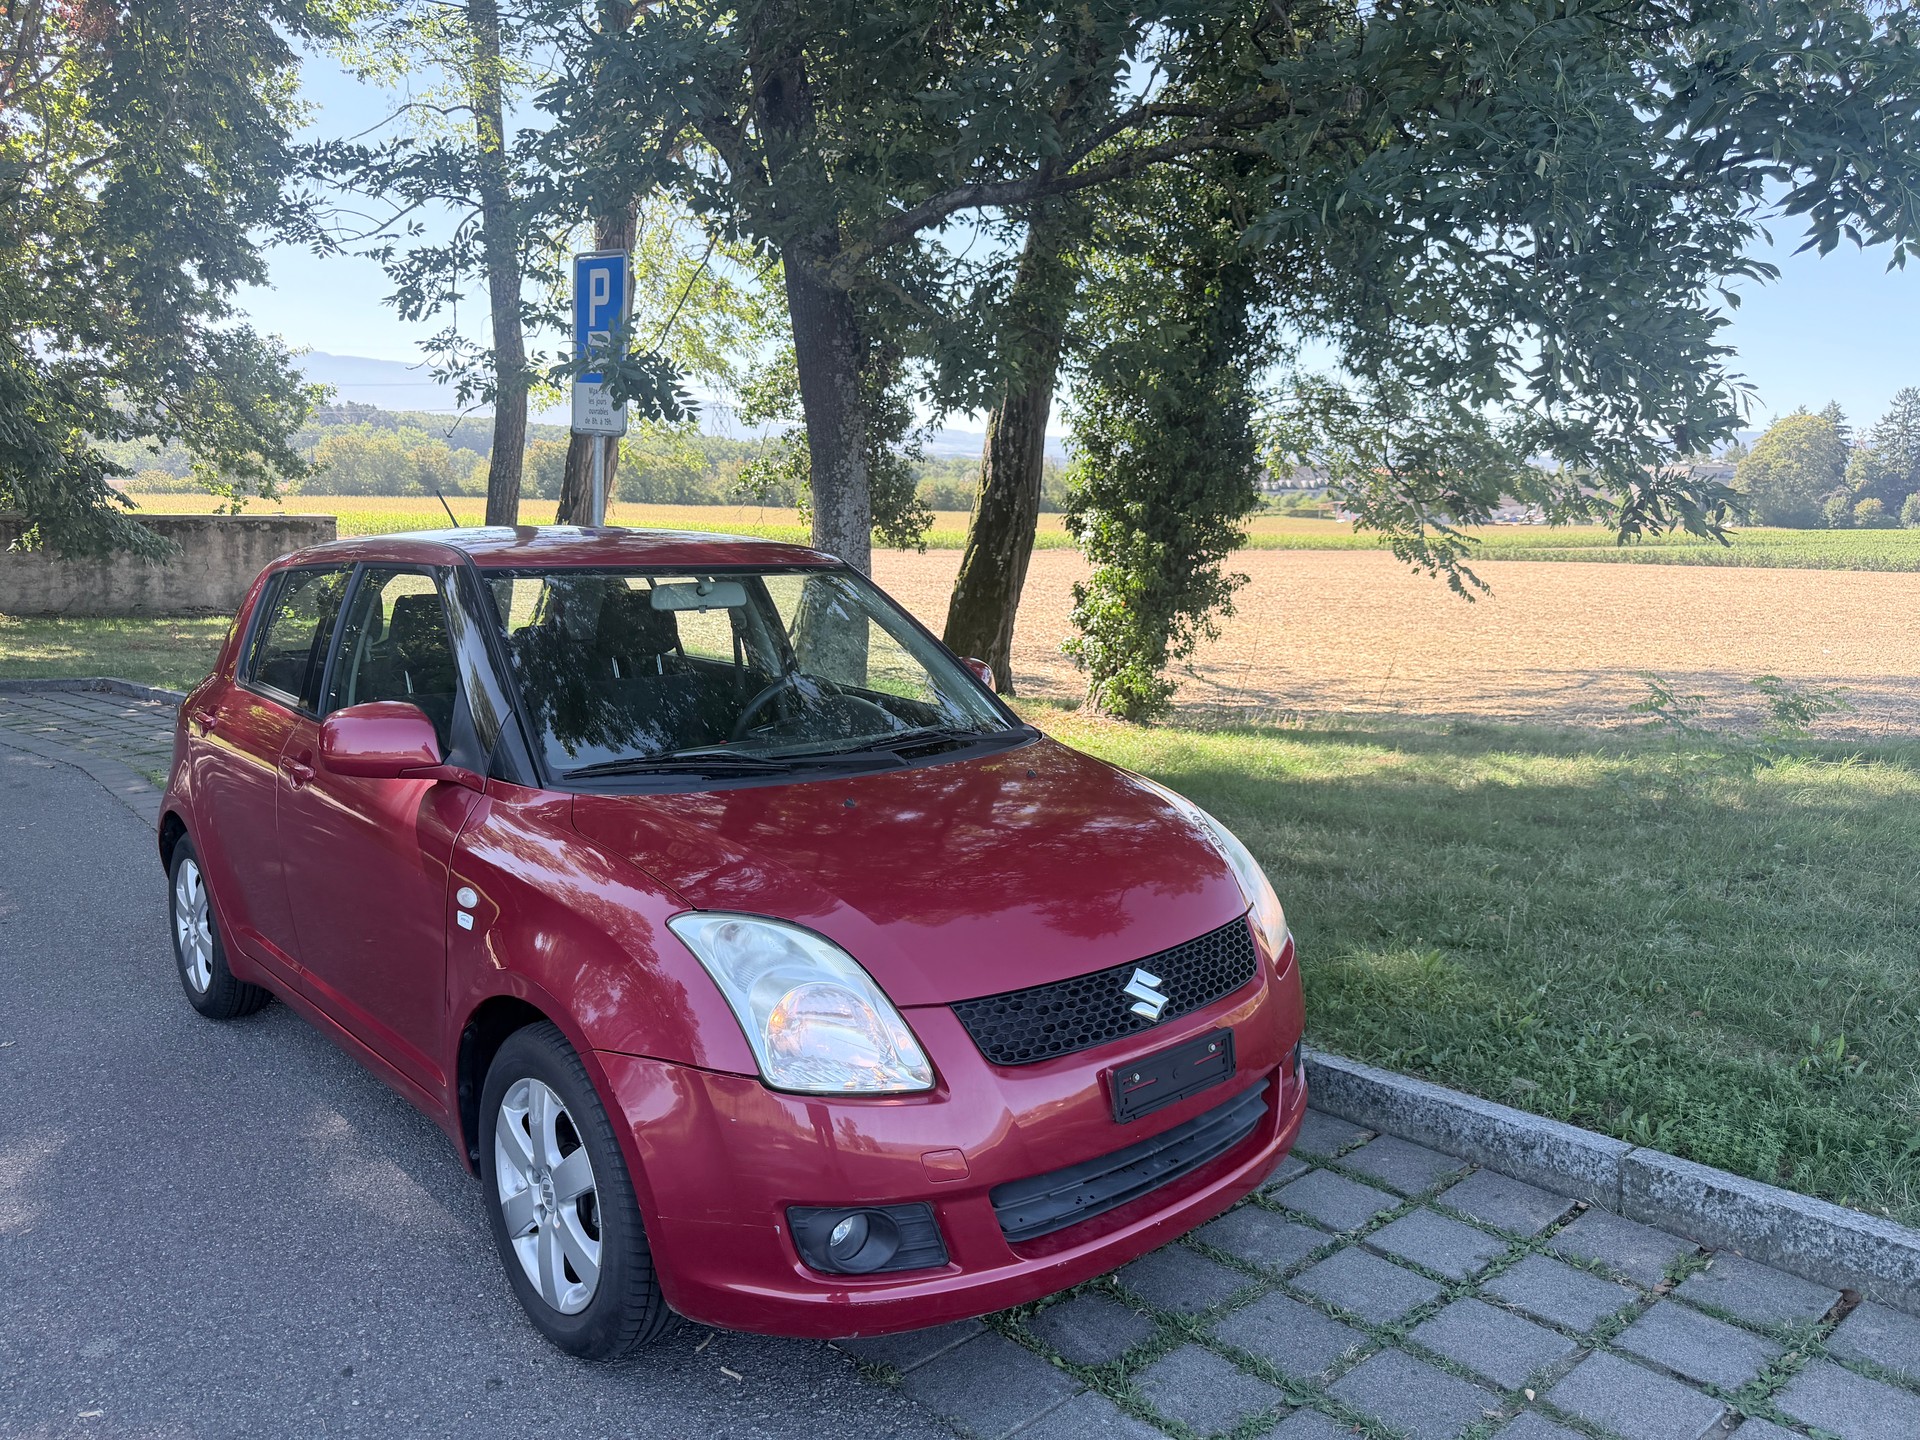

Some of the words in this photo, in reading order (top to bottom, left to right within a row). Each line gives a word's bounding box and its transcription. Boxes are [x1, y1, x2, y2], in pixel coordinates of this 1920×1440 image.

[589, 268, 610, 327] P
[596, 398, 607, 406] jours
[600, 417, 603, 425] à
